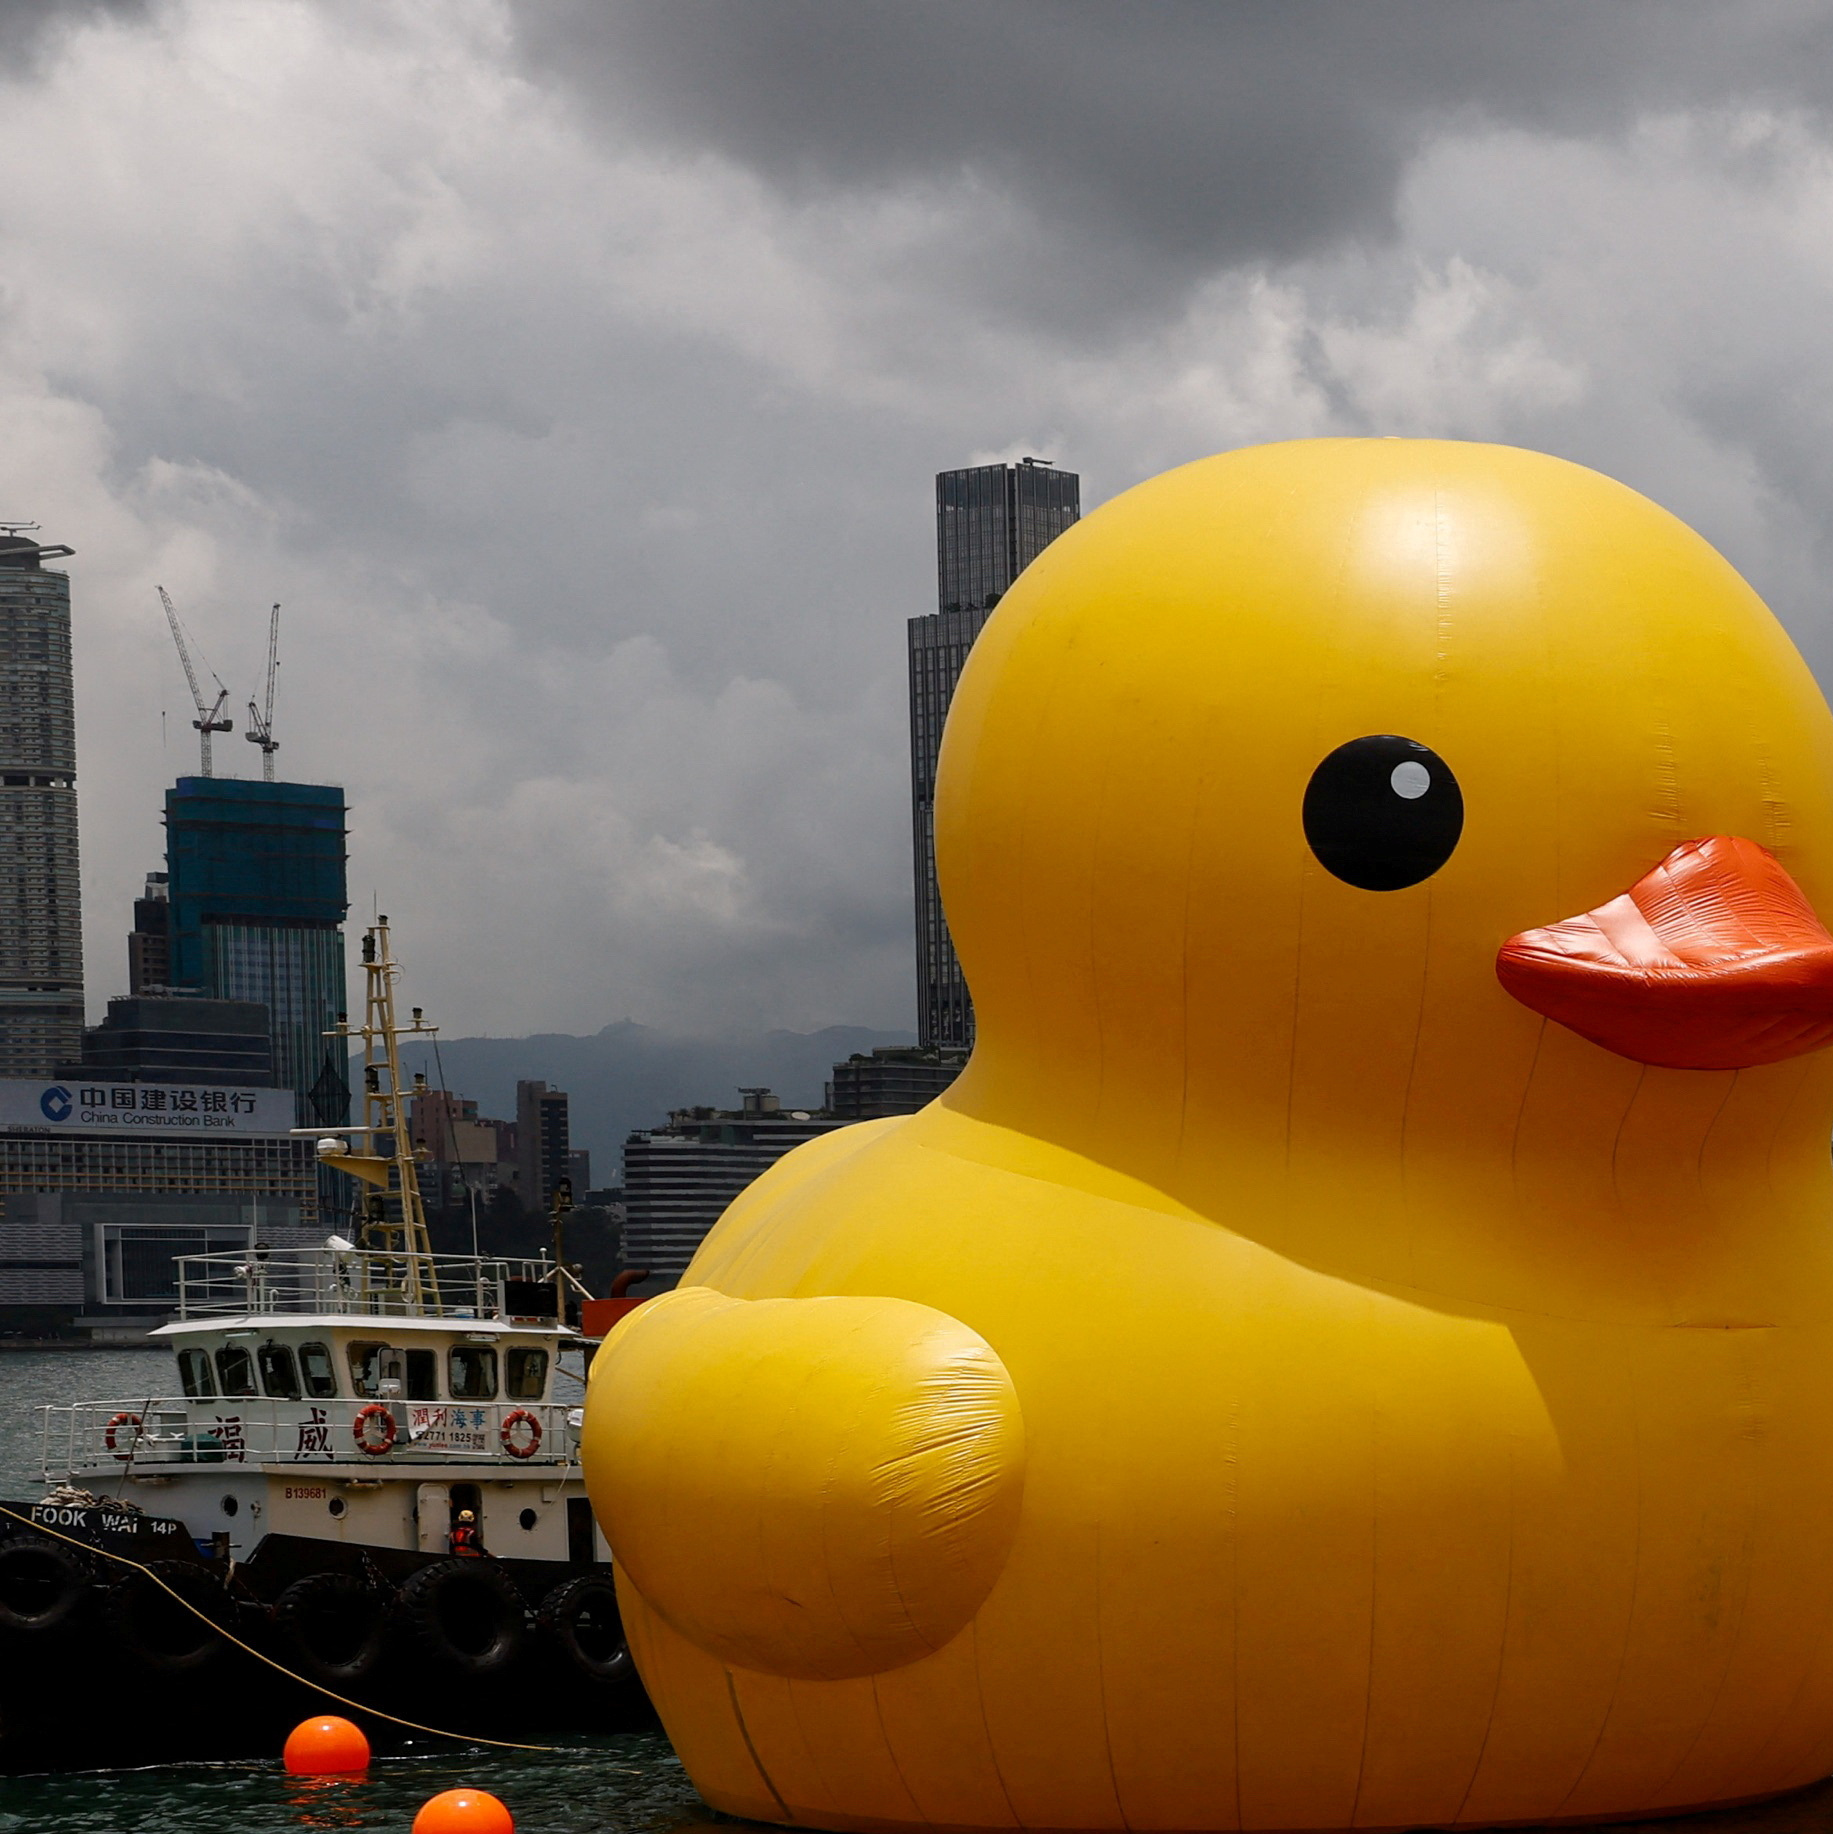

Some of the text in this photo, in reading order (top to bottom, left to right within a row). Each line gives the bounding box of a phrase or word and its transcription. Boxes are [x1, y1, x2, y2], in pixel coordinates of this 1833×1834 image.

[80, 1087, 256, 1114] 中国建设银行
[80, 1110, 235, 1128] China Construction Bank
[412, 1408, 486, 1430] 潤利海事
[295, 1407, 334, 1460] 威
[449, 1433, 471, 1442] 1825
[285, 1487, 327, 1499] B139681
[31, 1505, 88, 1528] FOOK
[150, 1519, 178, 1536] 14P
